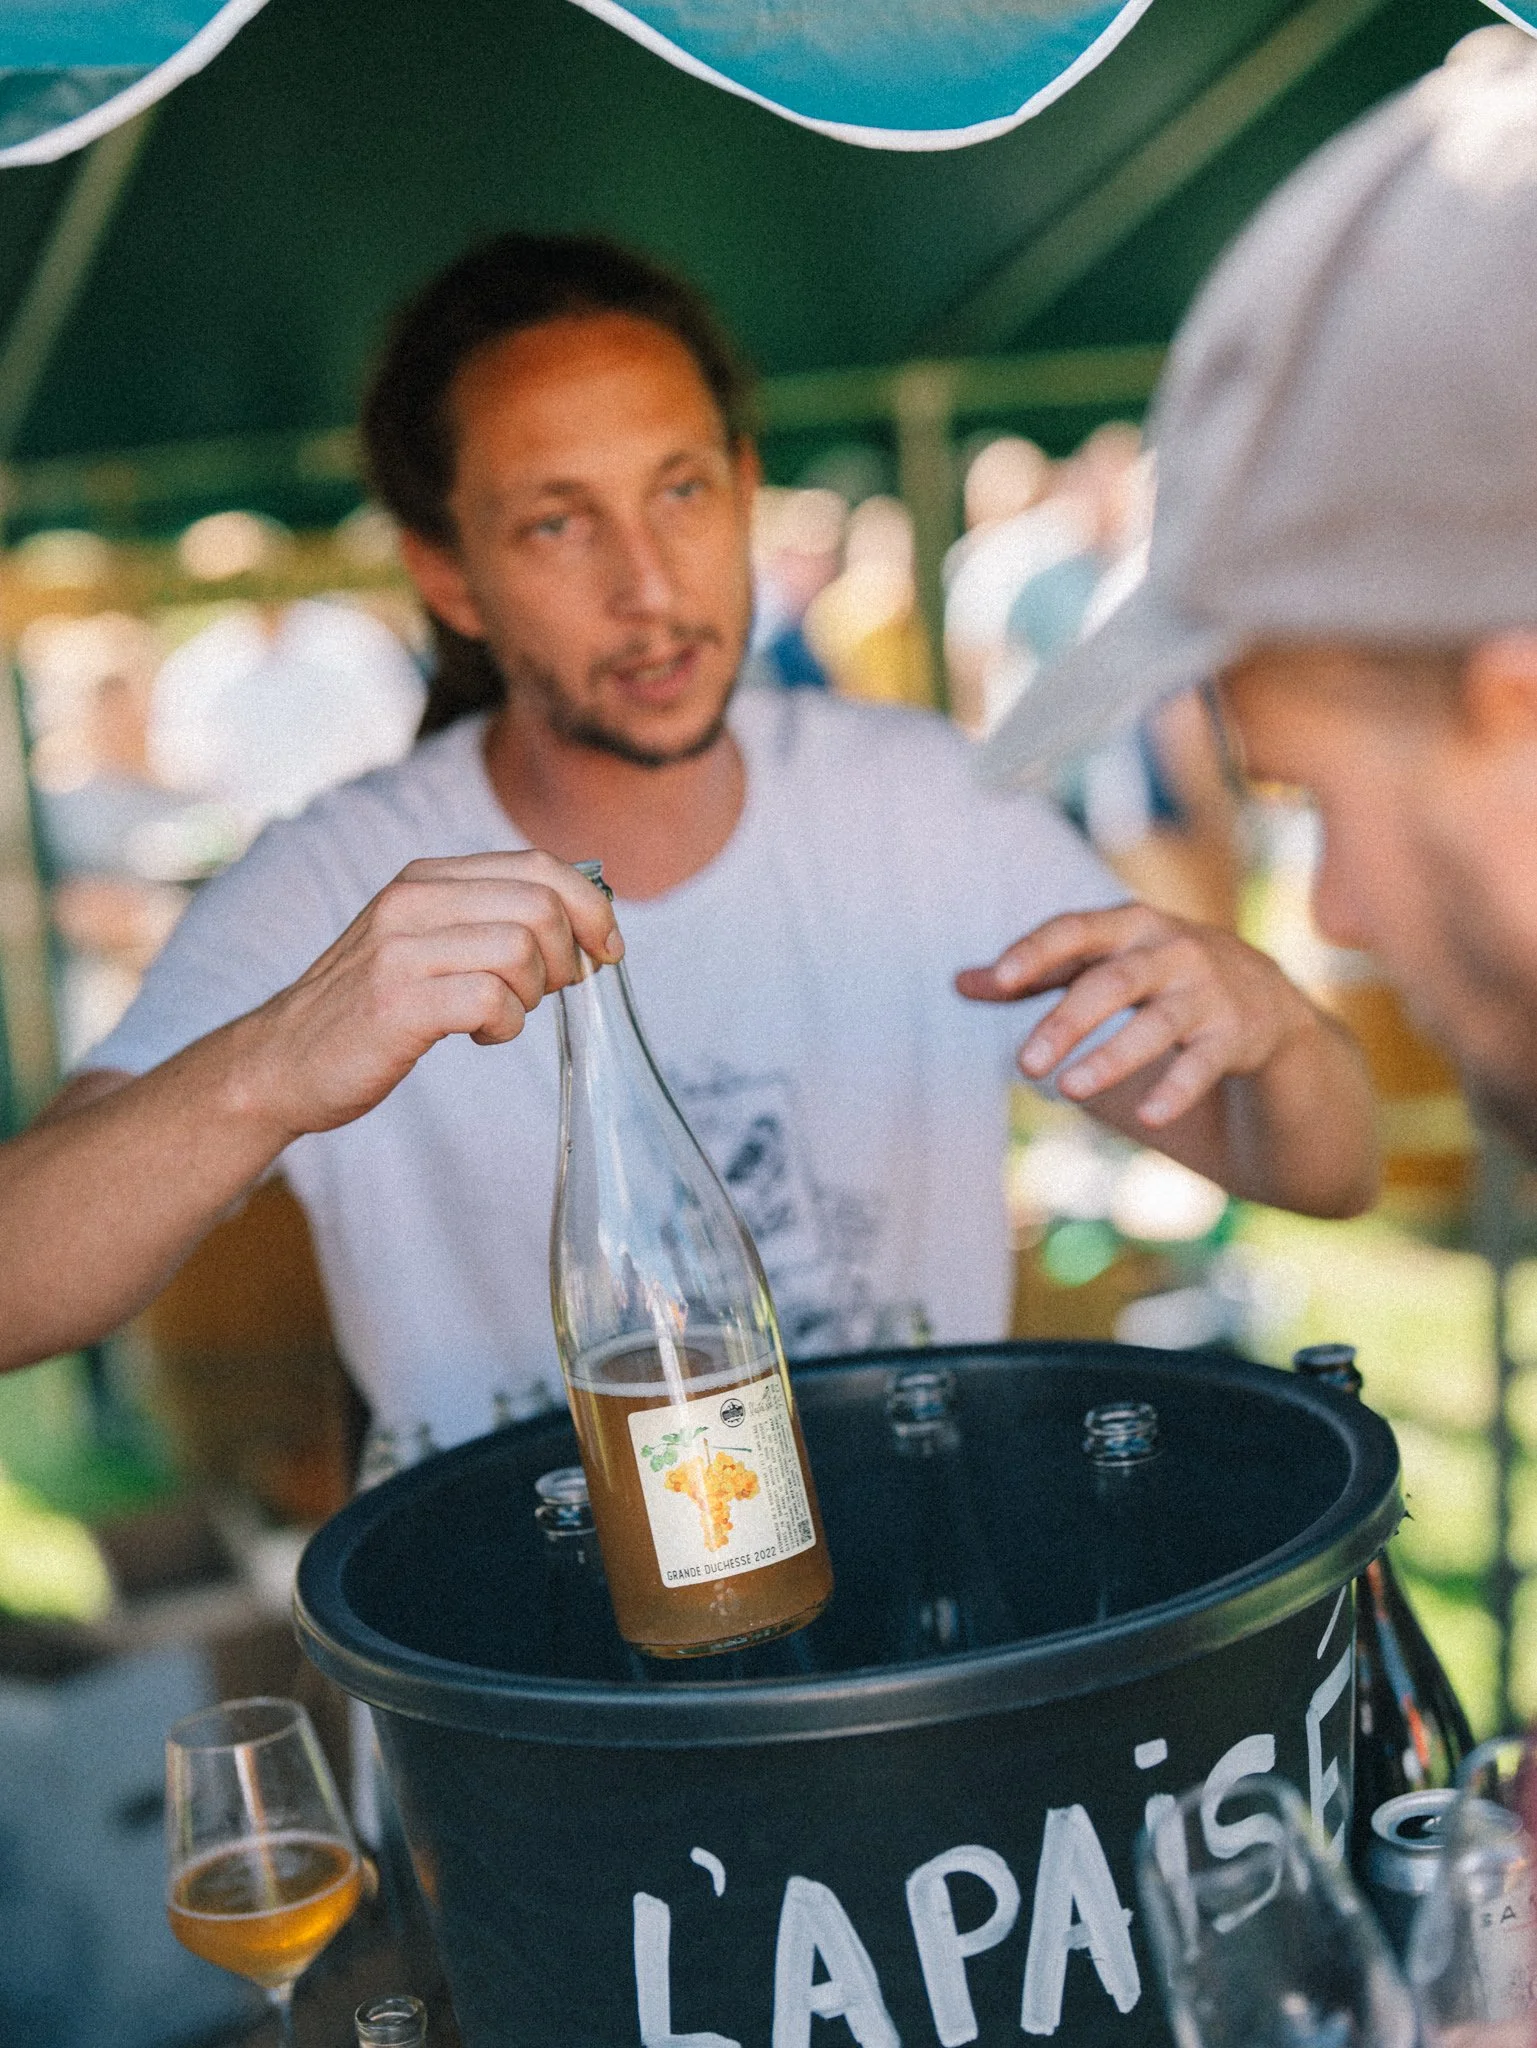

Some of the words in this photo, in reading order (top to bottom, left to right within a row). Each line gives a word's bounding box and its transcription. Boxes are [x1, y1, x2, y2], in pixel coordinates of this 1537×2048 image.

[667, 1566, 701, 1581] GRANDE
[704, 1554, 752, 1575] DUCHESSE
[754, 1546, 777, 1562] 2022
